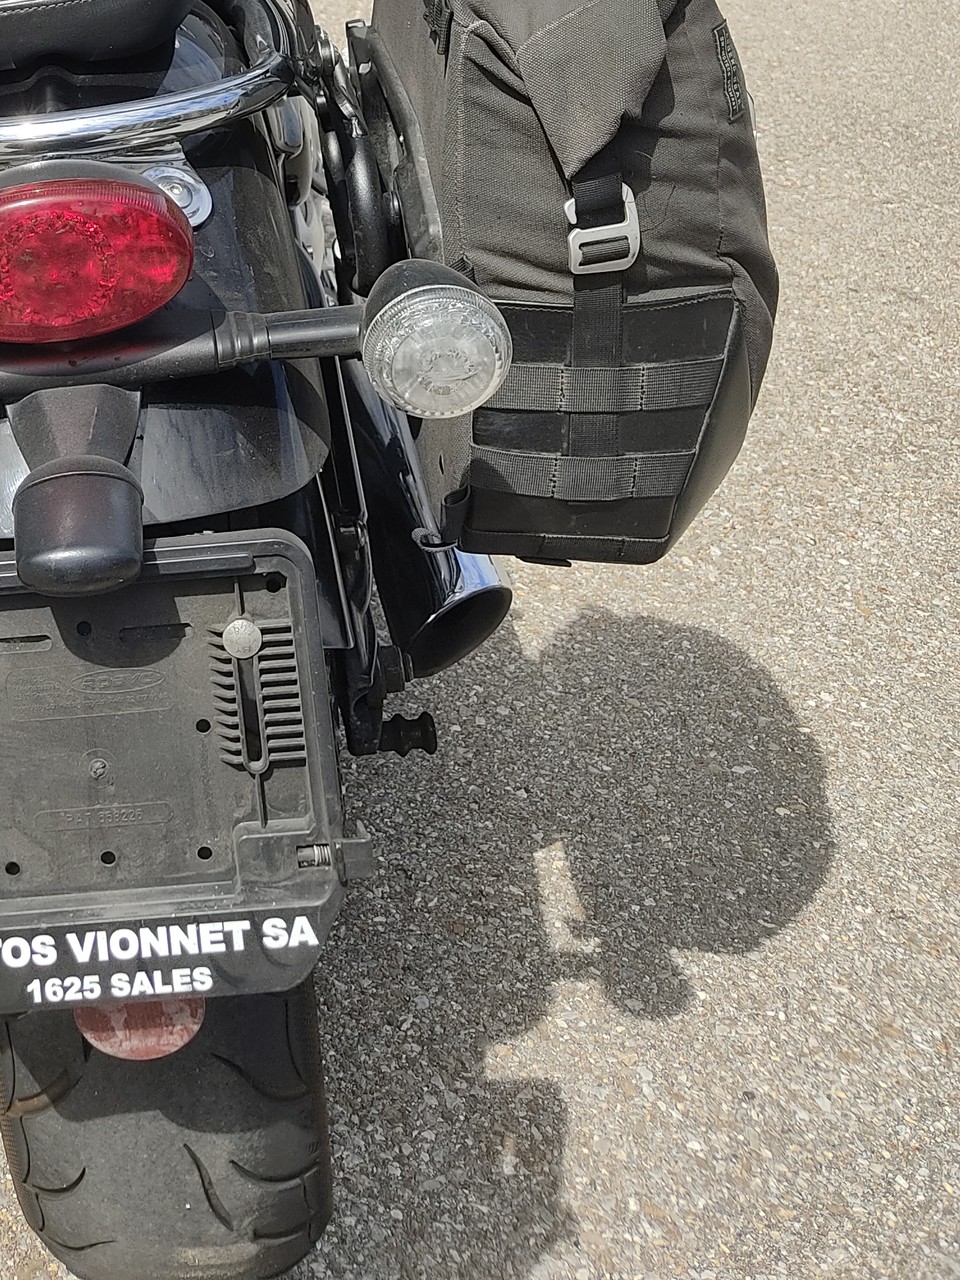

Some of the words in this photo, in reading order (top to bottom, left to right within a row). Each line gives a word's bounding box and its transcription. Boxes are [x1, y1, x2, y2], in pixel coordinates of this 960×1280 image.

[66, 920, 251, 964] VIONNET
[262, 915, 320, 949] SA
[25, 974, 102, 1004] 1625
[110, 966, 214, 998] SALES
